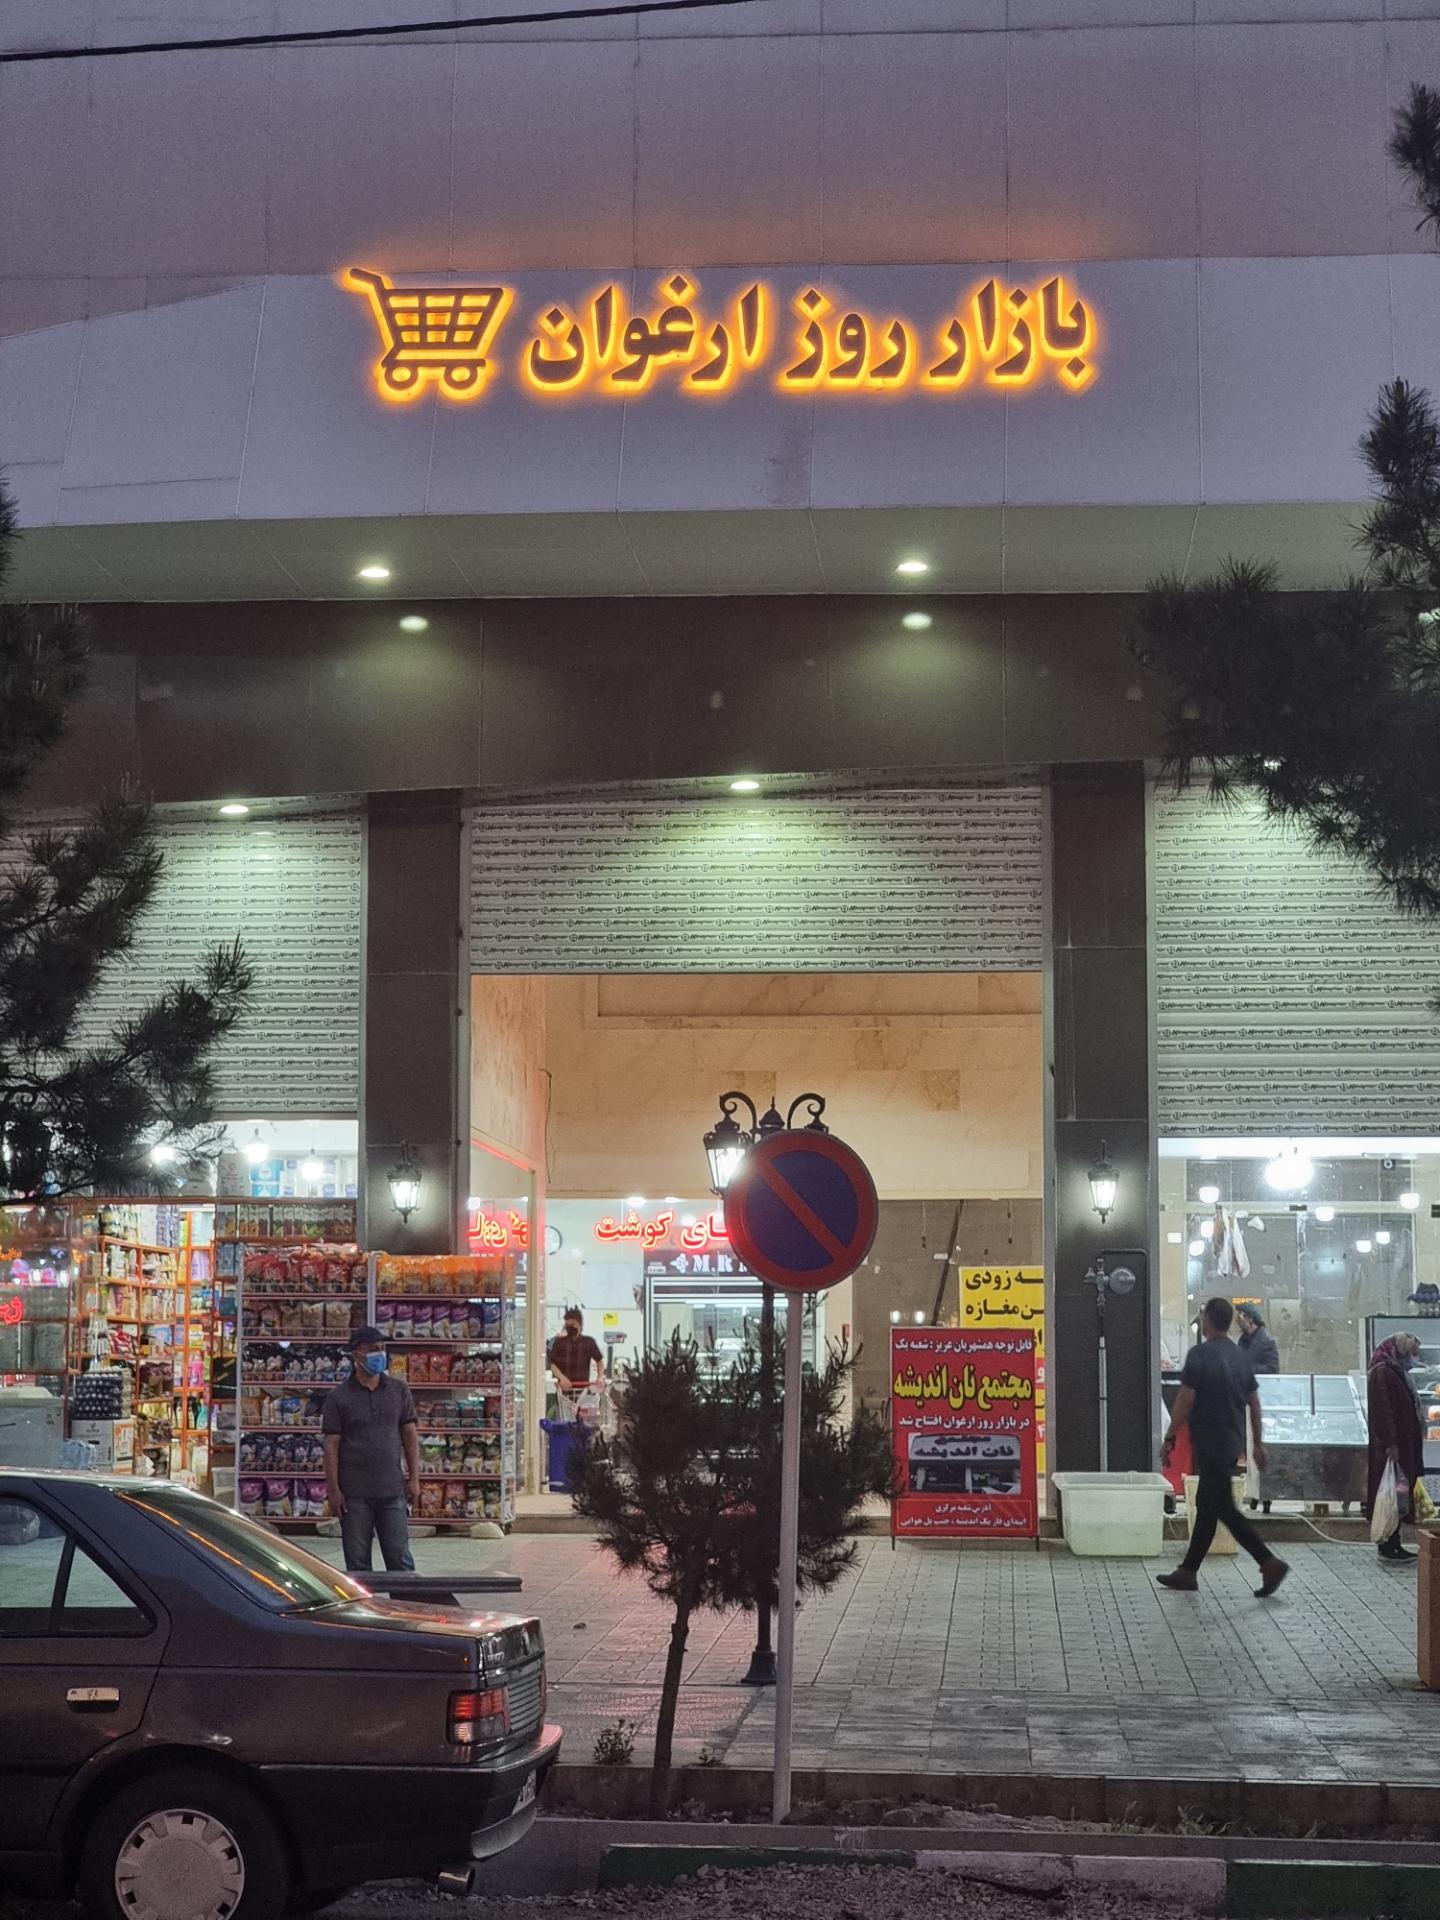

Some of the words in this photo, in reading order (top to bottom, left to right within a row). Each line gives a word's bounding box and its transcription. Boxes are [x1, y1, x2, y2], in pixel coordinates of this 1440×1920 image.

[532, 274, 762, 384] ارغوان
[783, 288, 906, 380] روز
[928, 278, 1088, 381] بازار
[594, 1208, 673, 1248] گوشت
[965, 1270, 1012, 1290] زودی
[965, 1299, 1020, 1321] مغازه
[994, 1339, 1014, 1353] توجه
[1015, 1338, 1033, 1353] قابل
[893, 1364, 948, 1408] اندیشه
[949, 1364, 976, 1409] نان
[977, 1369, 1032, 1410] مجتمع
[898, 1415, 913, 1426] شد
[914, 1415, 942, 1429] افتتاح
[943, 1415, 975, 1429] ارغوان
[979, 1416, 994, 1429] روز
[995, 1415, 1017, 1429] بازار
[1018, 1417, 1030, 1430] در
